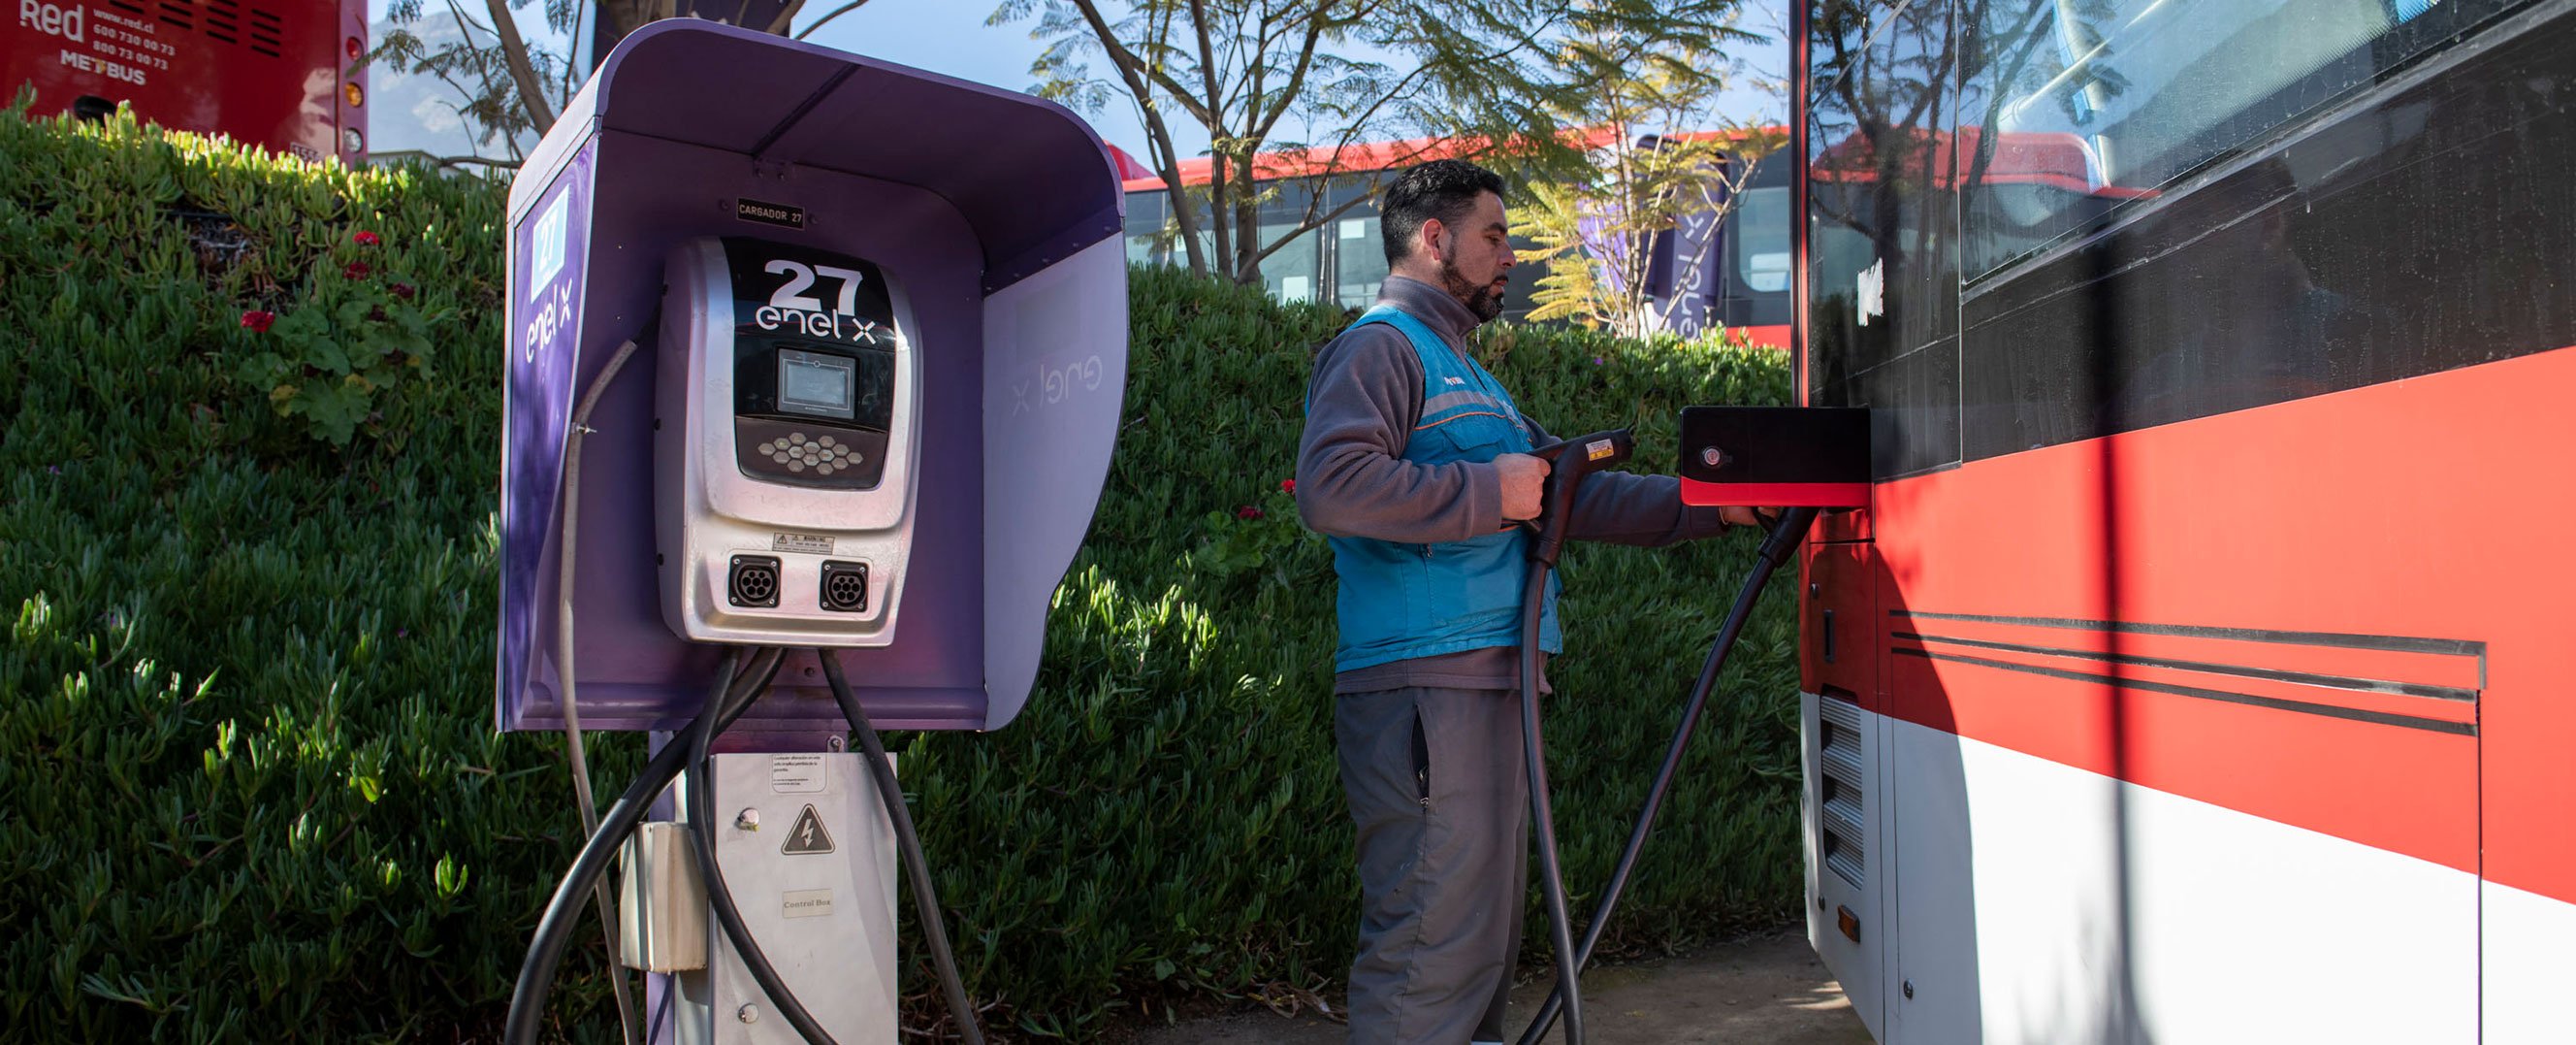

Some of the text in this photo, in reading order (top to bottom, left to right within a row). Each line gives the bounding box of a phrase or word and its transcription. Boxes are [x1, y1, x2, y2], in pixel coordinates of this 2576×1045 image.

[19, 0, 84, 43] Red
[93, 9, 155, 34] www.red.cl
[93, 24, 176, 56] 600 730 00 73
[93, 40, 169, 70] 800 73 00 73
[739, 204, 802, 223] CARGADOR 27
[538, 207, 558, 273] 27
[764, 259, 863, 316] 27
[526, 283, 558, 364] enel
[756, 306, 842, 340] enel
[783, 898, 831, 909] Control Box
